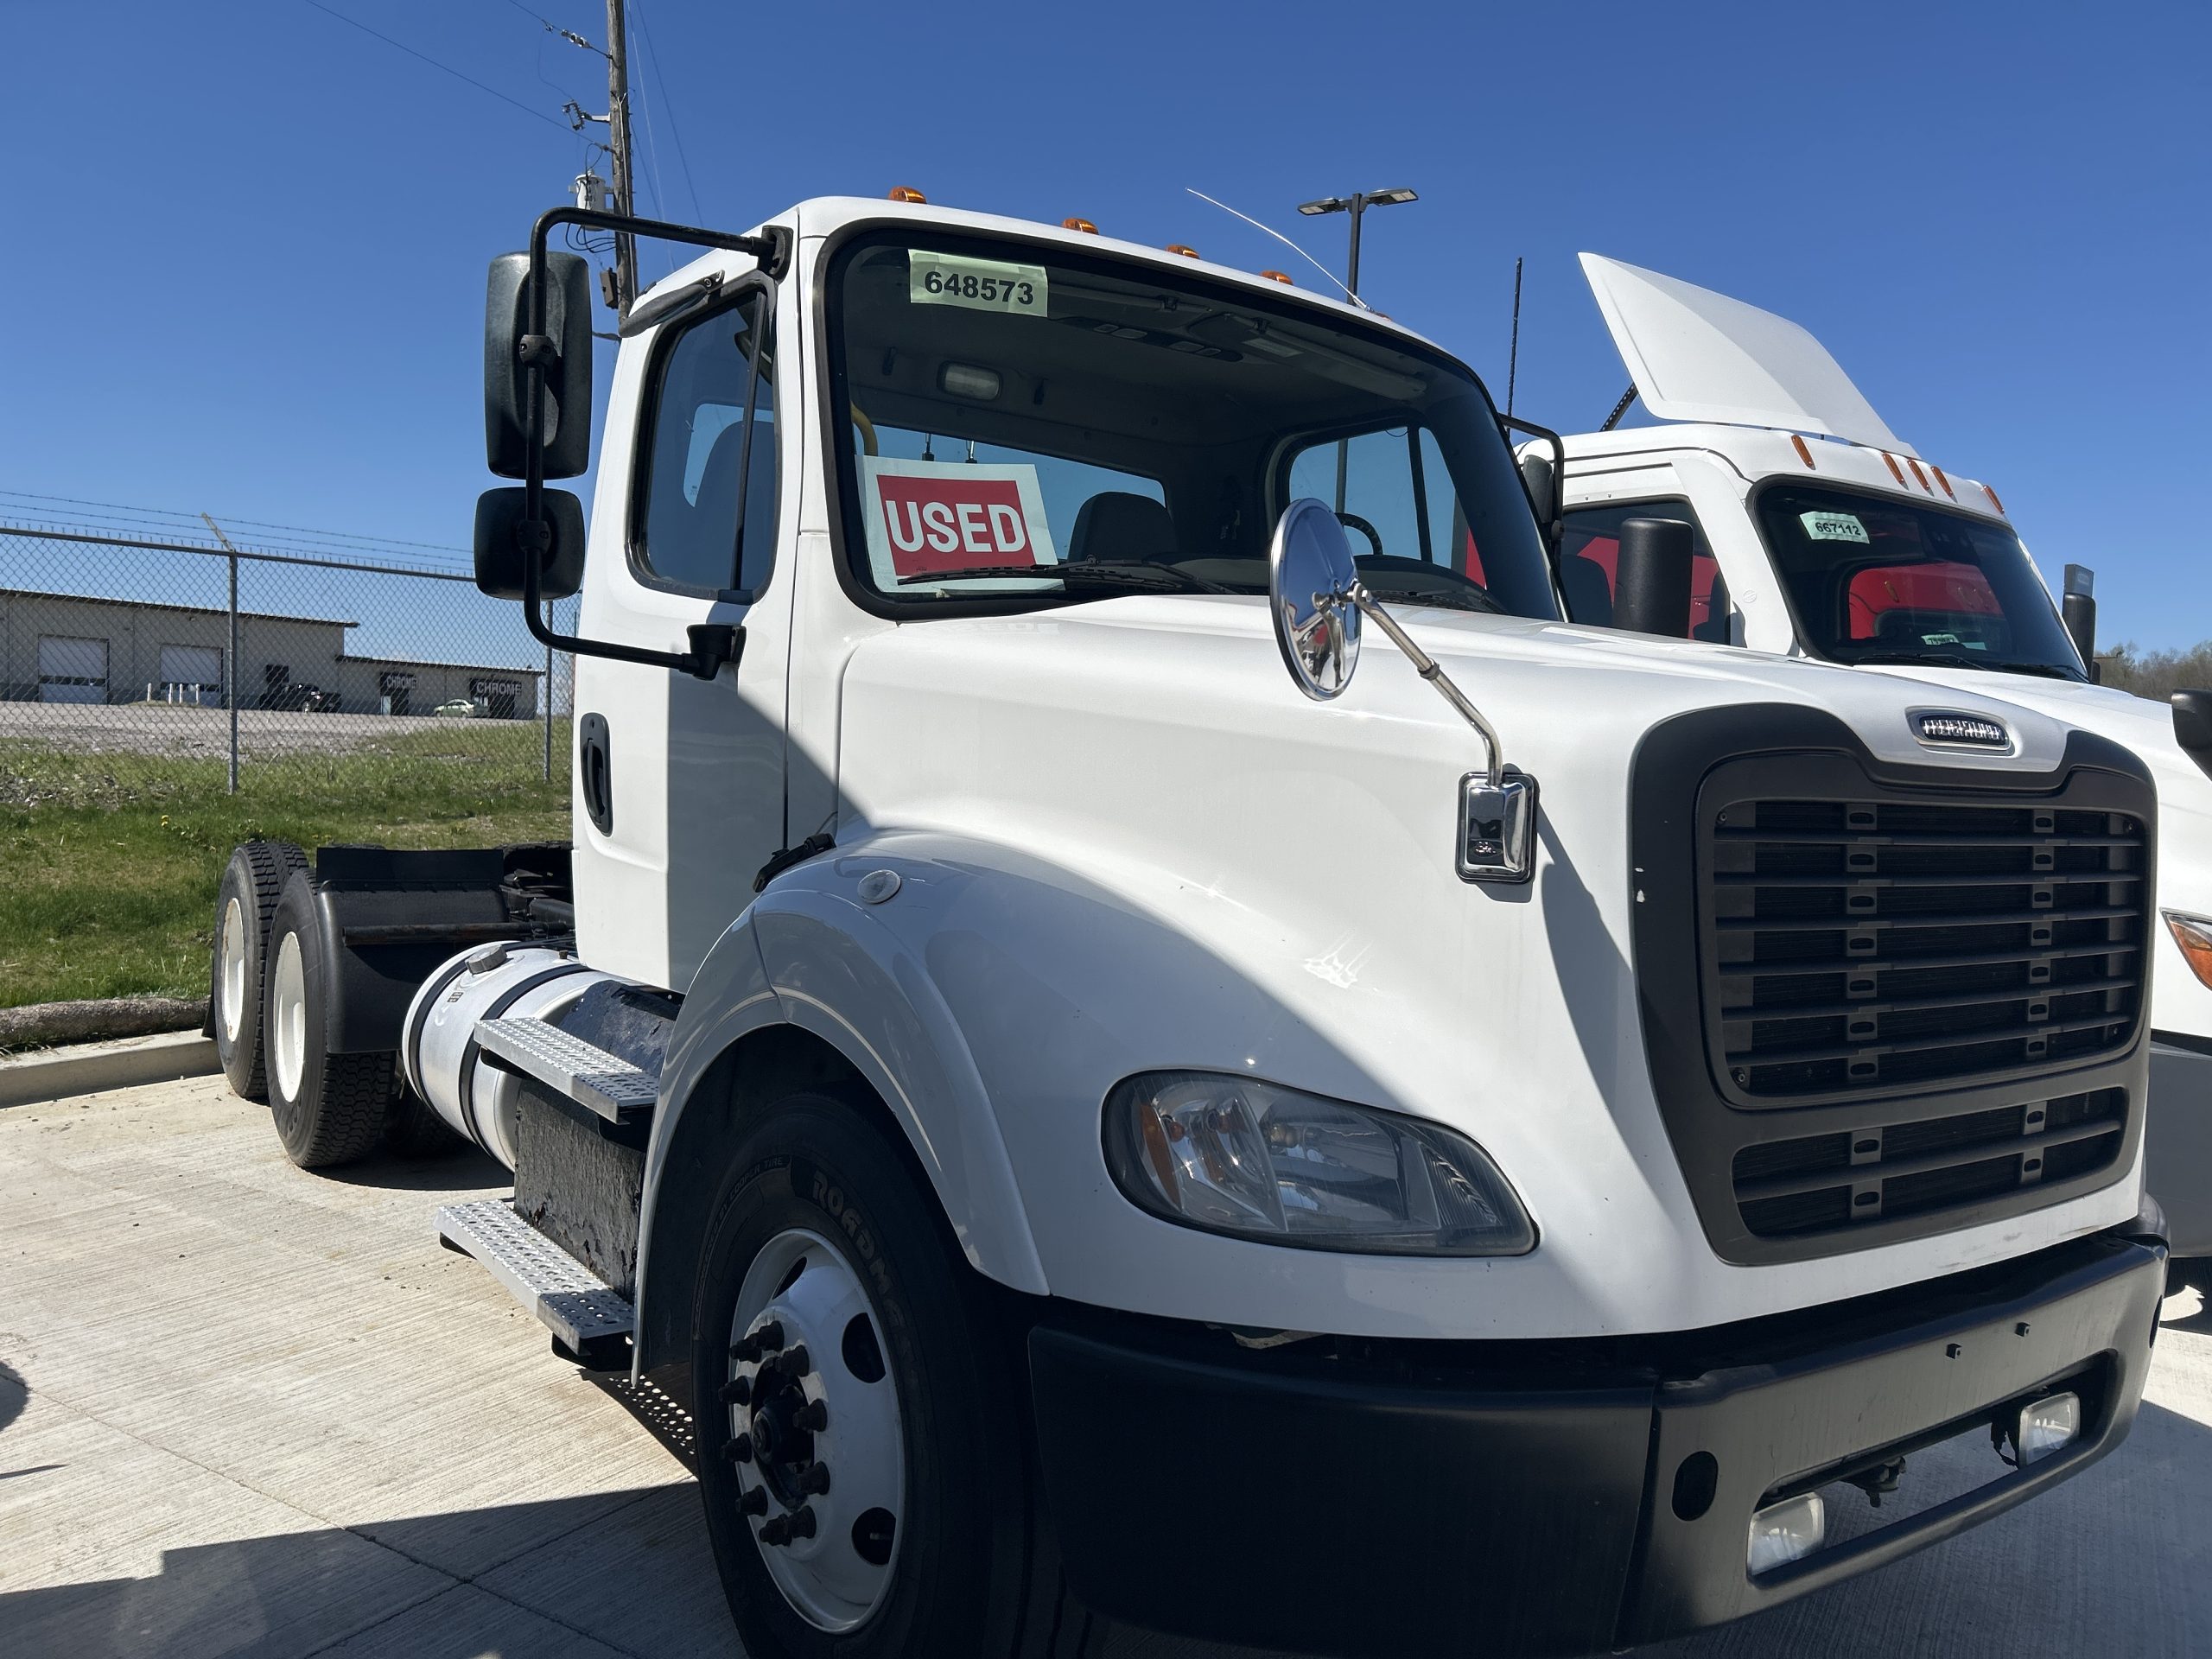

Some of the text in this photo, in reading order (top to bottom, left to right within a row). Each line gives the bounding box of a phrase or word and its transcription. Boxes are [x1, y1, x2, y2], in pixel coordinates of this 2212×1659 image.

[925, 270, 1034, 305] 648573
[885, 500, 1027, 553] USED
[1815, 522, 1861, 536] 667112
[386, 676, 417, 690] CHROME
[476, 682, 522, 695] CHROME
